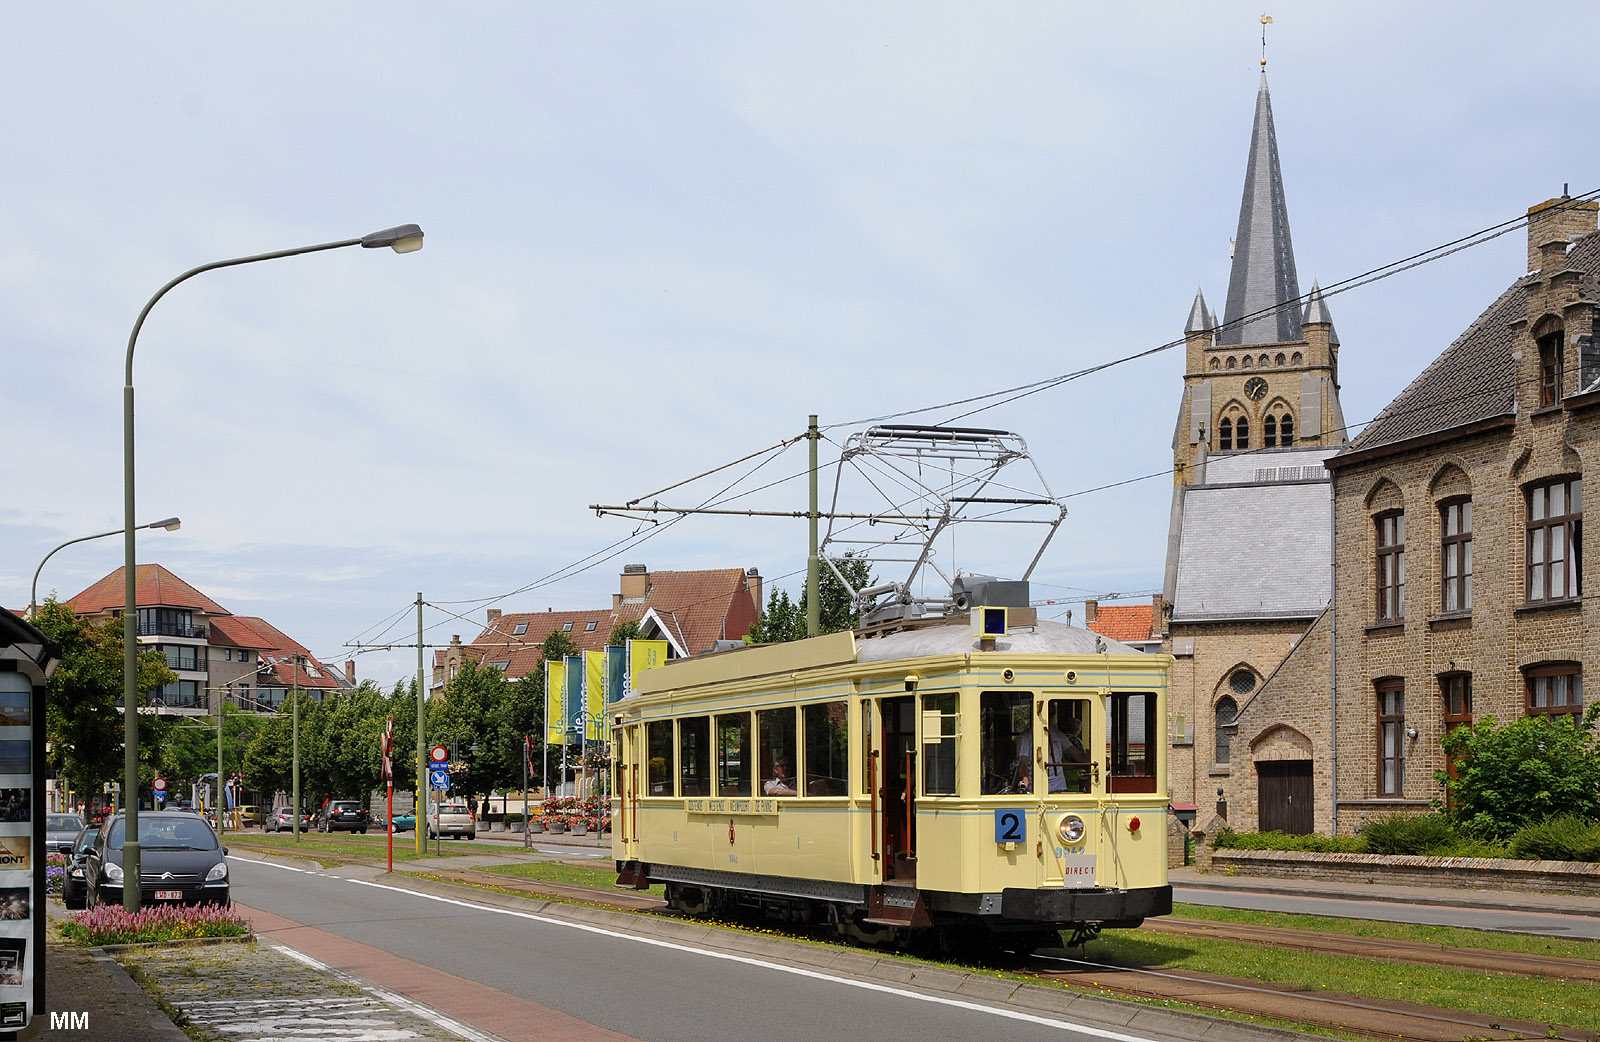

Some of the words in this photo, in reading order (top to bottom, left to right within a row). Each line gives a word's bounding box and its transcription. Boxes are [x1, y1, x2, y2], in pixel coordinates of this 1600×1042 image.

[549, 720, 563, 734] de
[1000, 814, 1022, 840] 2
[0, 856, 25, 864] ONT
[1065, 866, 1094, 874] DIRECT
